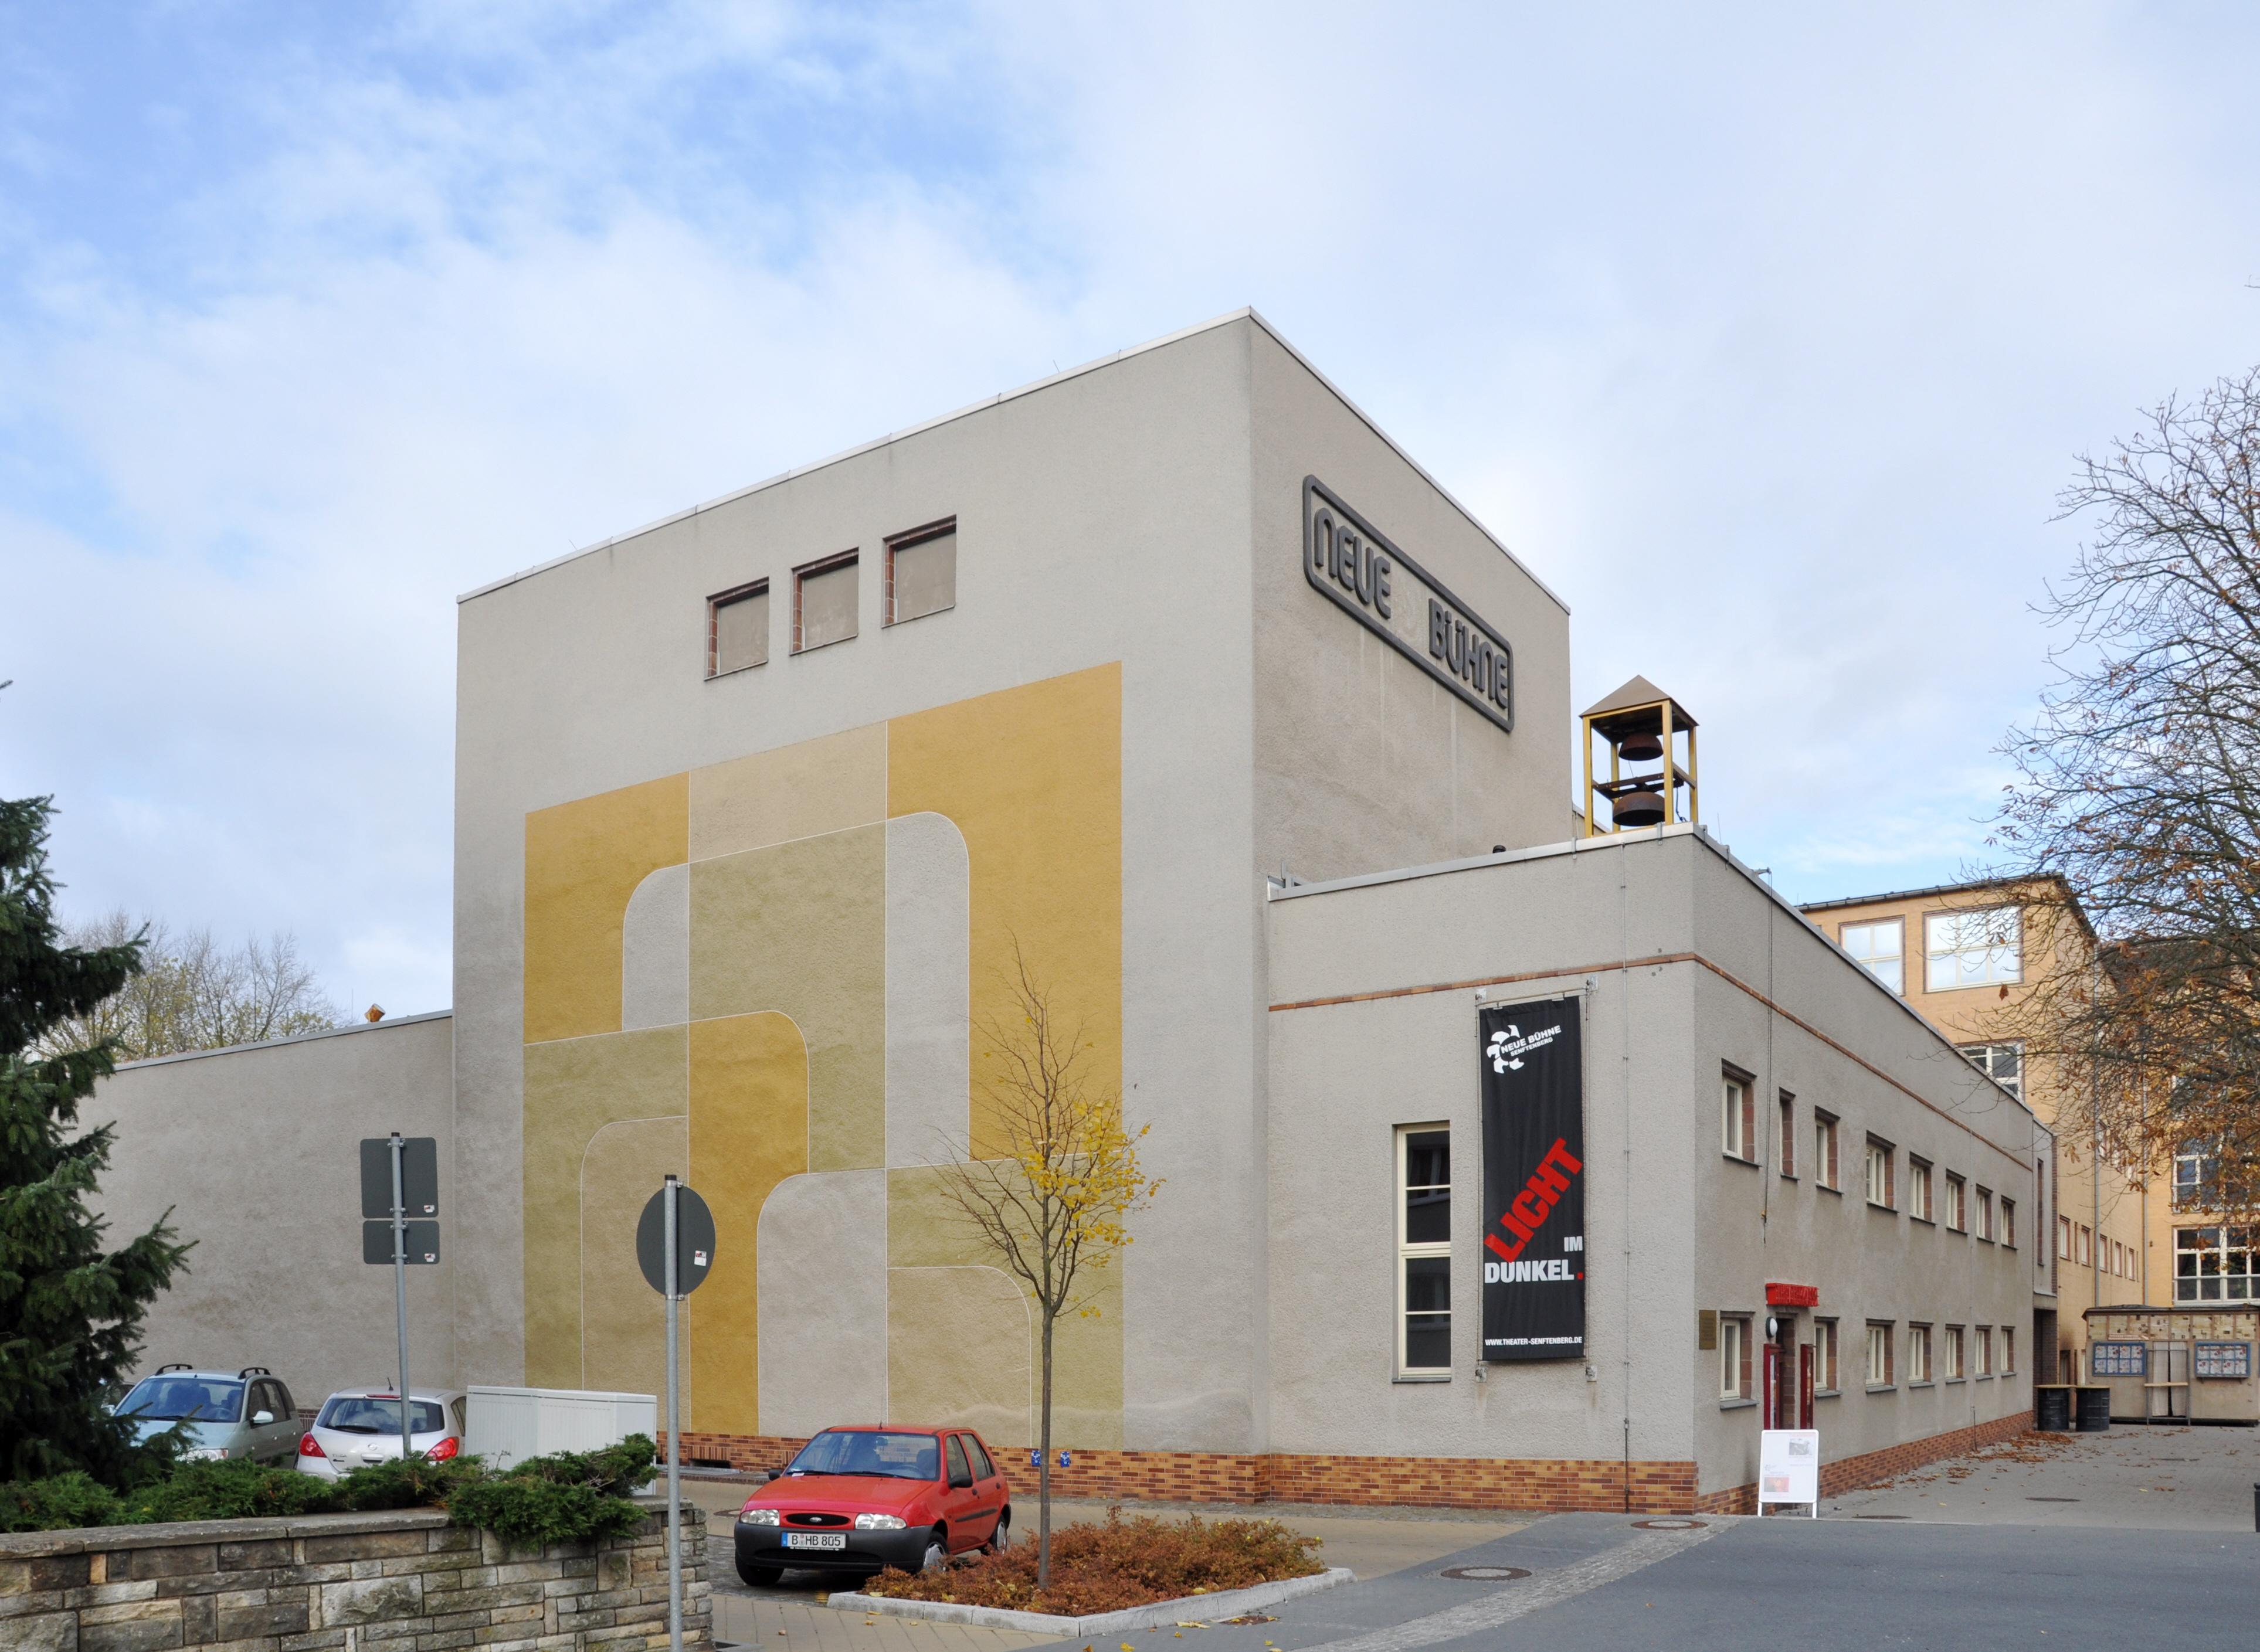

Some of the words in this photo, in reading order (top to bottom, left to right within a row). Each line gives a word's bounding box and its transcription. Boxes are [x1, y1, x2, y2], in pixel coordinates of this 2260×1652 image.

[1314, 508, 1392, 620] NEUE
[1428, 597, 1508, 709] BÜHNE
[1501, 1038, 1527, 1054] NEUE
[1527, 1025, 1562, 1043] BÜHNE
[1510, 1036, 1553, 1056] SENFTENBERG
[1484, 1137, 1583, 1263] LICHT
[1564, 1236, 1583, 1252] IM
[1485, 1337, 1583, 1346] WWW.THEATER-SENFTENBERG.DE
[792, 1535, 798, 1545] B
[805, 1535, 819, 1546] HB
[822, 1536, 841, 1546] 805
